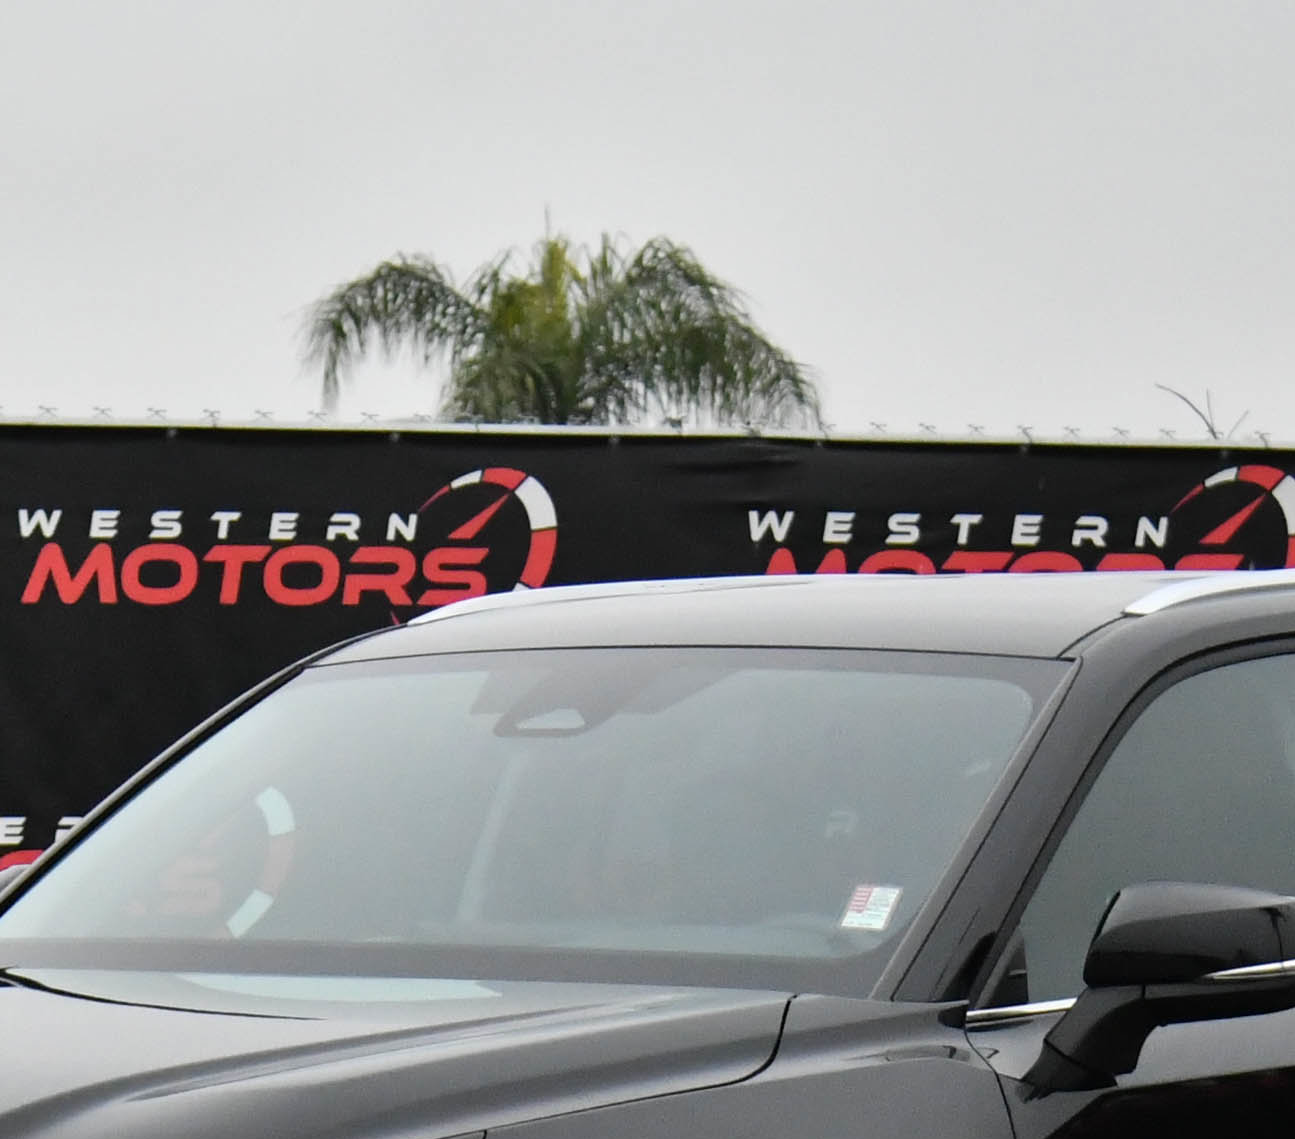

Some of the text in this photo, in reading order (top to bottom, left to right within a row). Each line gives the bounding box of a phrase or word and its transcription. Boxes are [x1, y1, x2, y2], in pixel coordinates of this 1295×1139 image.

[18, 508, 418, 541] WESTERN
[748, 510, 1169, 547] WESTERN
[20, 541, 490, 607] MOTORS
